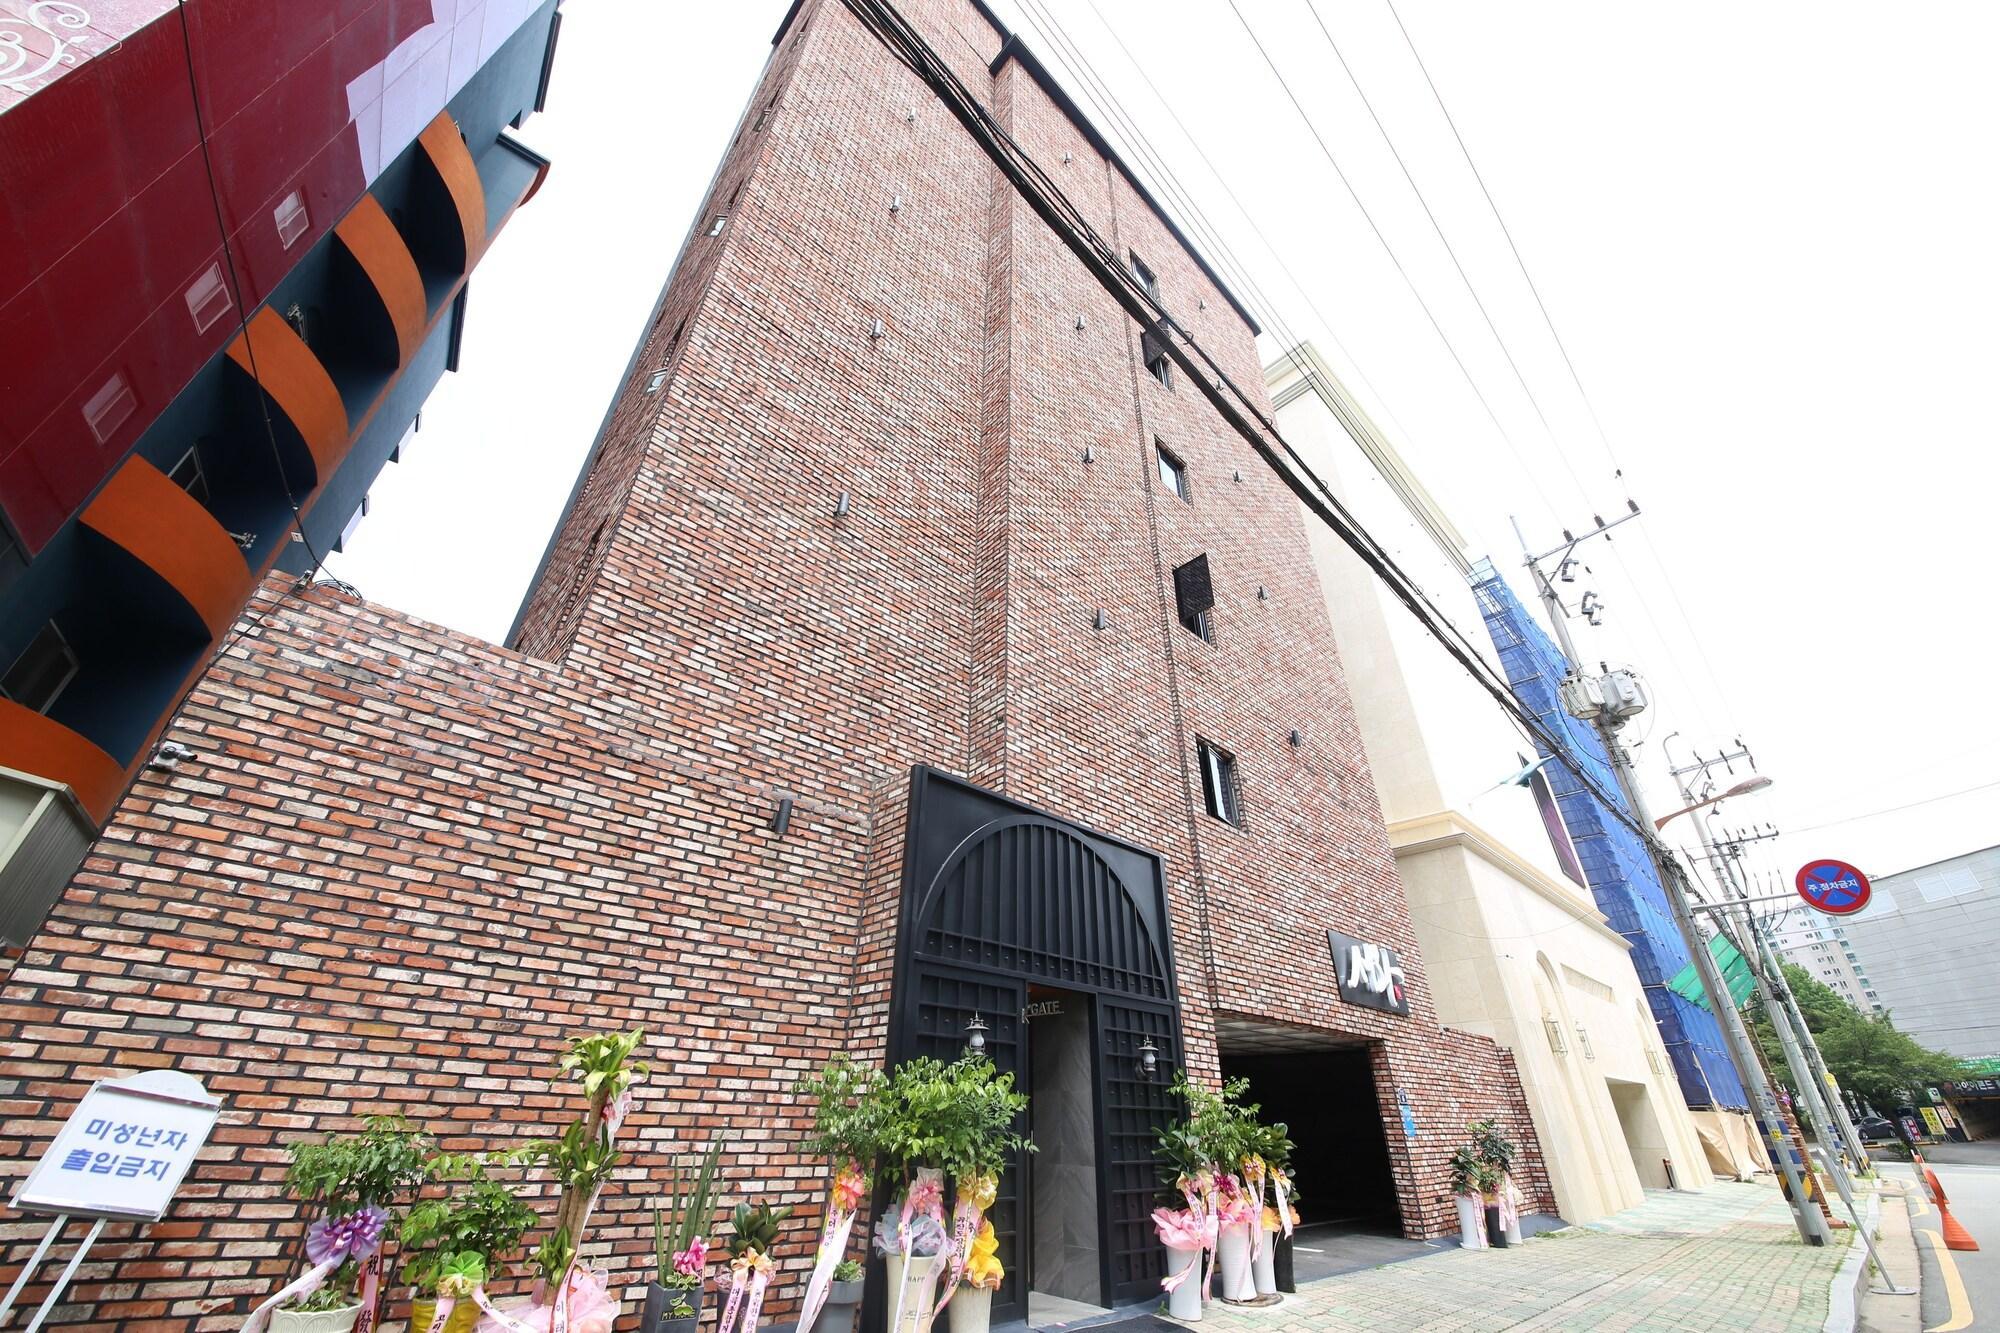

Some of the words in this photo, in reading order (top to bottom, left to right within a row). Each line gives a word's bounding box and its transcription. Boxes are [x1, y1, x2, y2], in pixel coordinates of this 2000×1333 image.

[1808, 878, 1858, 892] 주.정차금지
[84, 1118, 188, 1151] 미성년자
[60, 1148, 171, 1181] 출입금지
